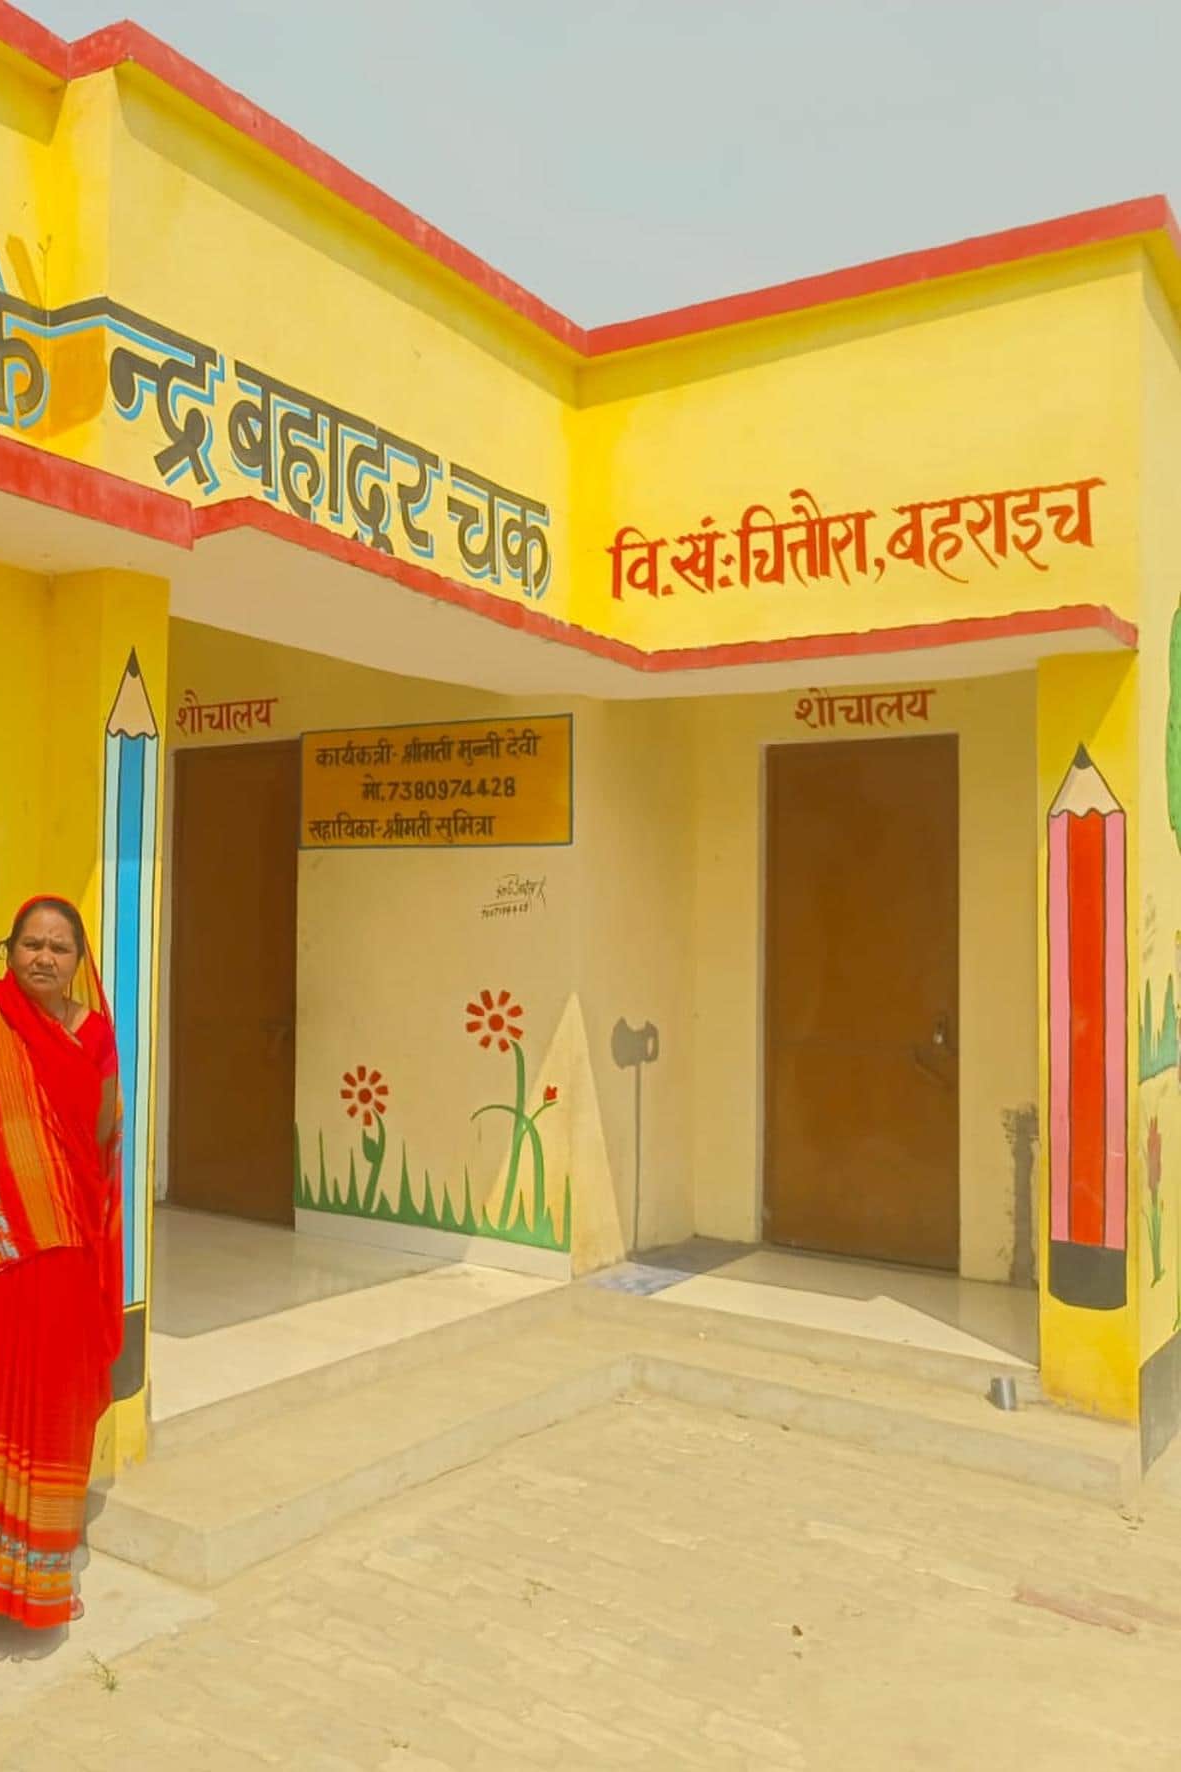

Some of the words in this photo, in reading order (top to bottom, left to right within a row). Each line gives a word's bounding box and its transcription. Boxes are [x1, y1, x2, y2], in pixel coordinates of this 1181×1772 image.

[446, 462, 552, 600] चक
[886, 477, 1107, 584] बहराइच
[175, 688, 279, 738] शौचालय
